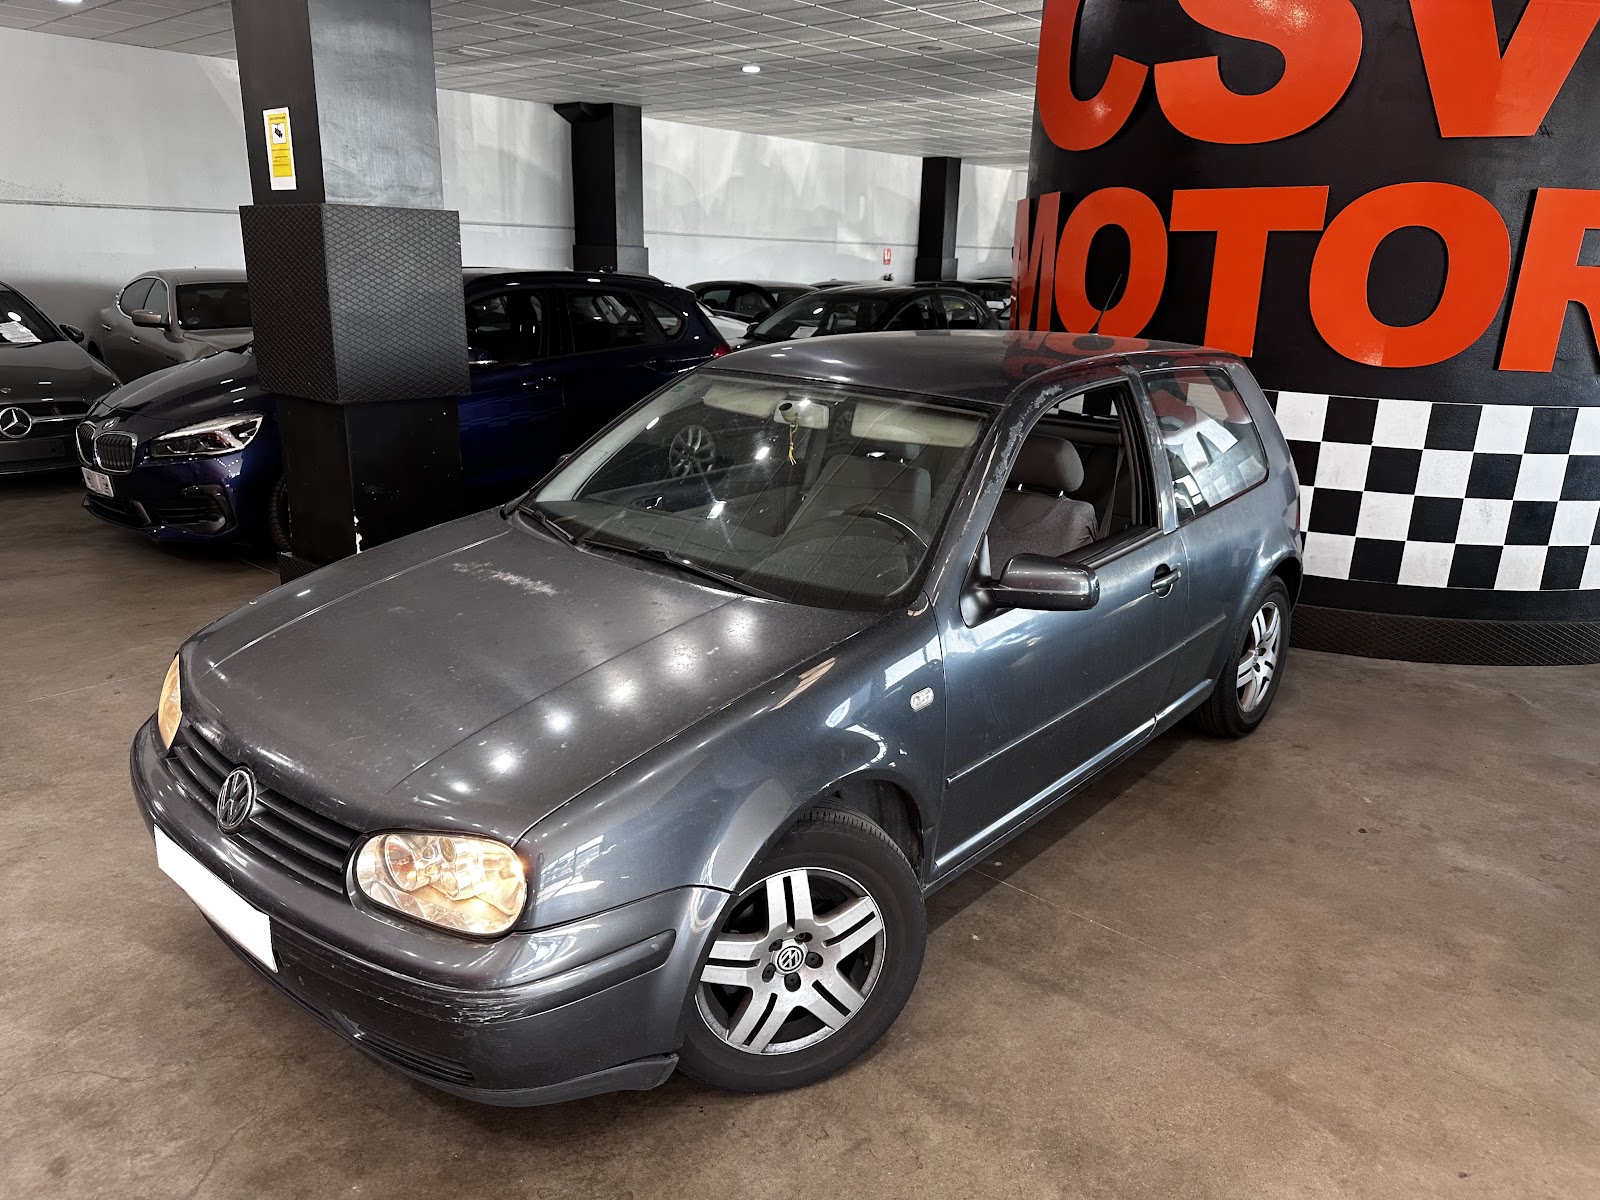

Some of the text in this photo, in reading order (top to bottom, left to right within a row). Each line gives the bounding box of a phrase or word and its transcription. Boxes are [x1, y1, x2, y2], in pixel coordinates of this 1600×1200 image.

[1038, 0, 1600, 151] CSV
[1009, 182, 1600, 372] MOTOR
[217, 770, 253, 829] VW
[778, 947, 803, 971] VW
